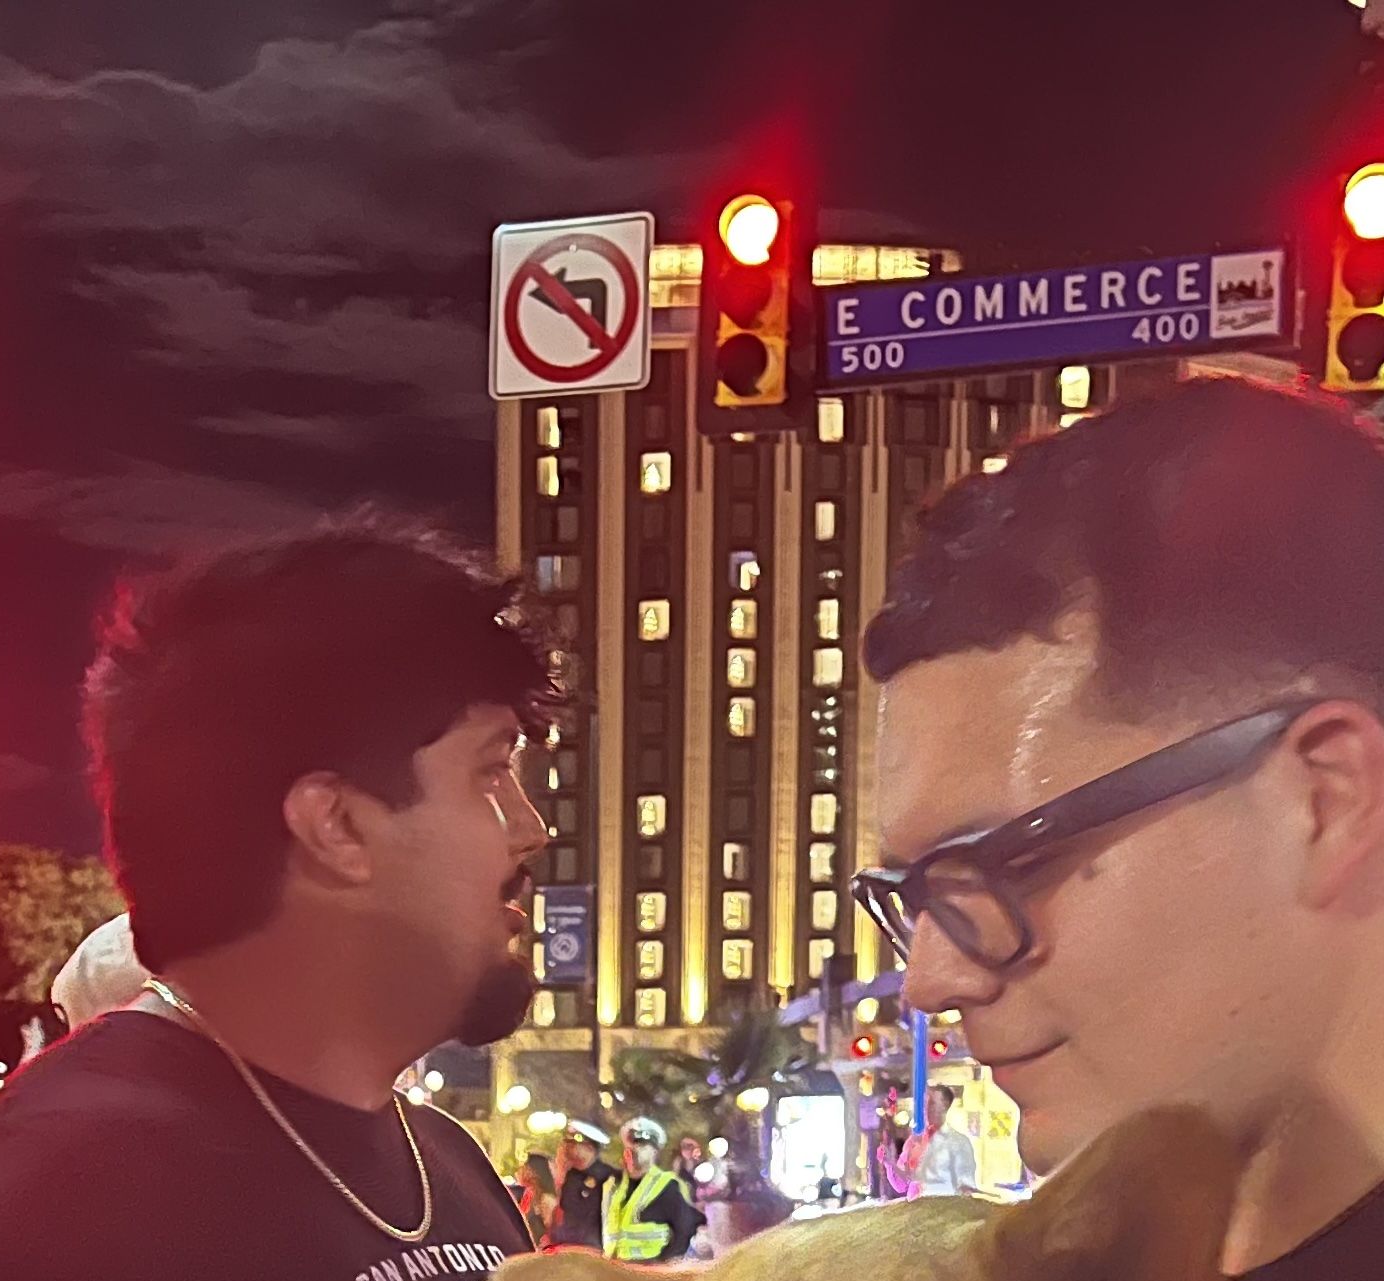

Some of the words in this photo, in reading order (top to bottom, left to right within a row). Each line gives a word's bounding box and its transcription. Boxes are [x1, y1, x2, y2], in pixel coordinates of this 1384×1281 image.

[837, 298, 861, 336] E
[900, 262, 1201, 330] COMMERCE
[1131, 313, 1200, 343] 400
[841, 341, 905, 374] 500
